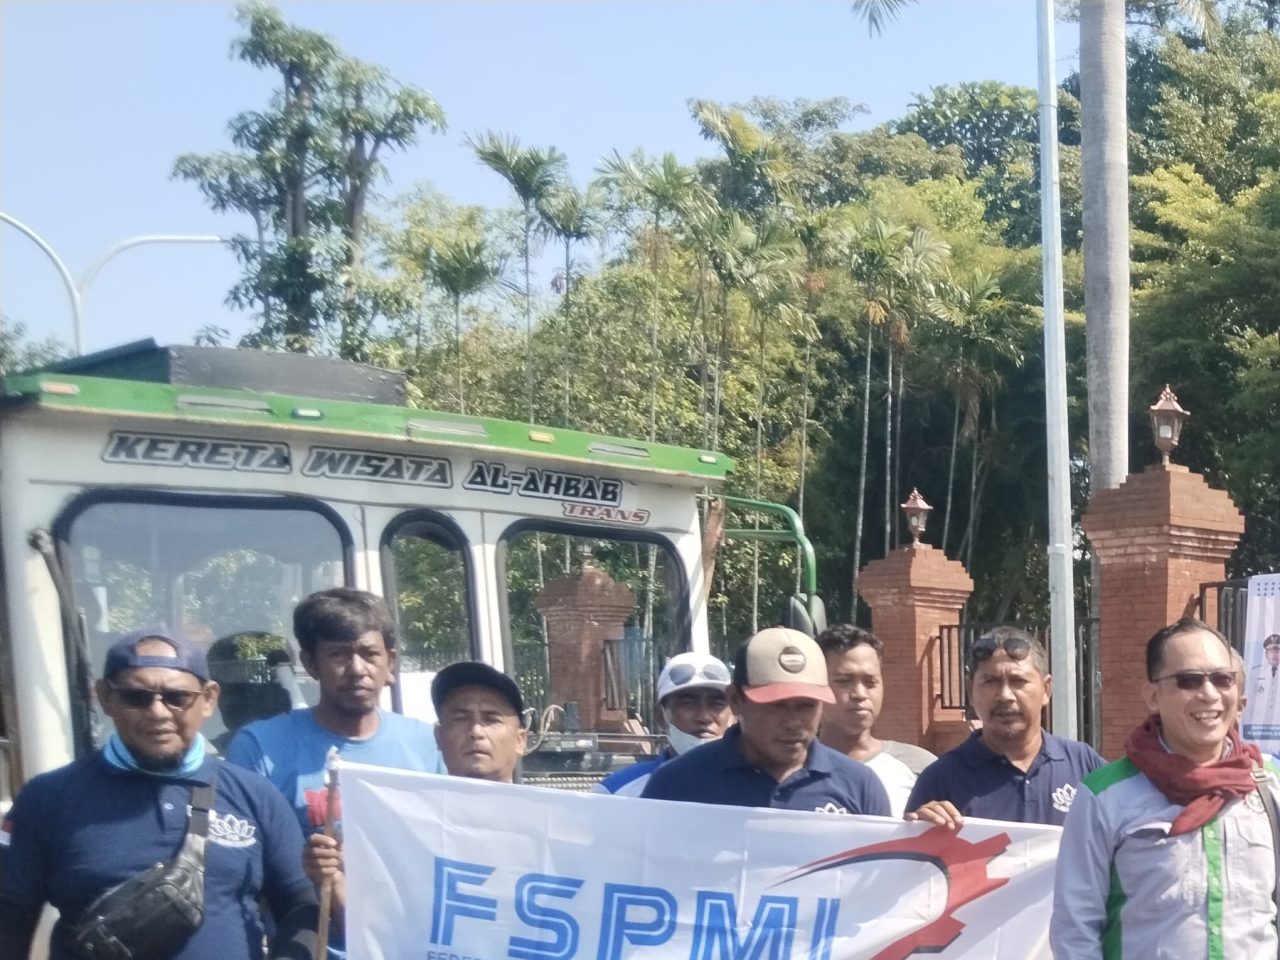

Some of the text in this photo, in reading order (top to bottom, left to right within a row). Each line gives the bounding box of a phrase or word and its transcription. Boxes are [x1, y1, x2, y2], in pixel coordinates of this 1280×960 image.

[105, 432, 620, 504] KERETA WISATA AL-AHBAB
[563, 503, 648, 524] TRANS
